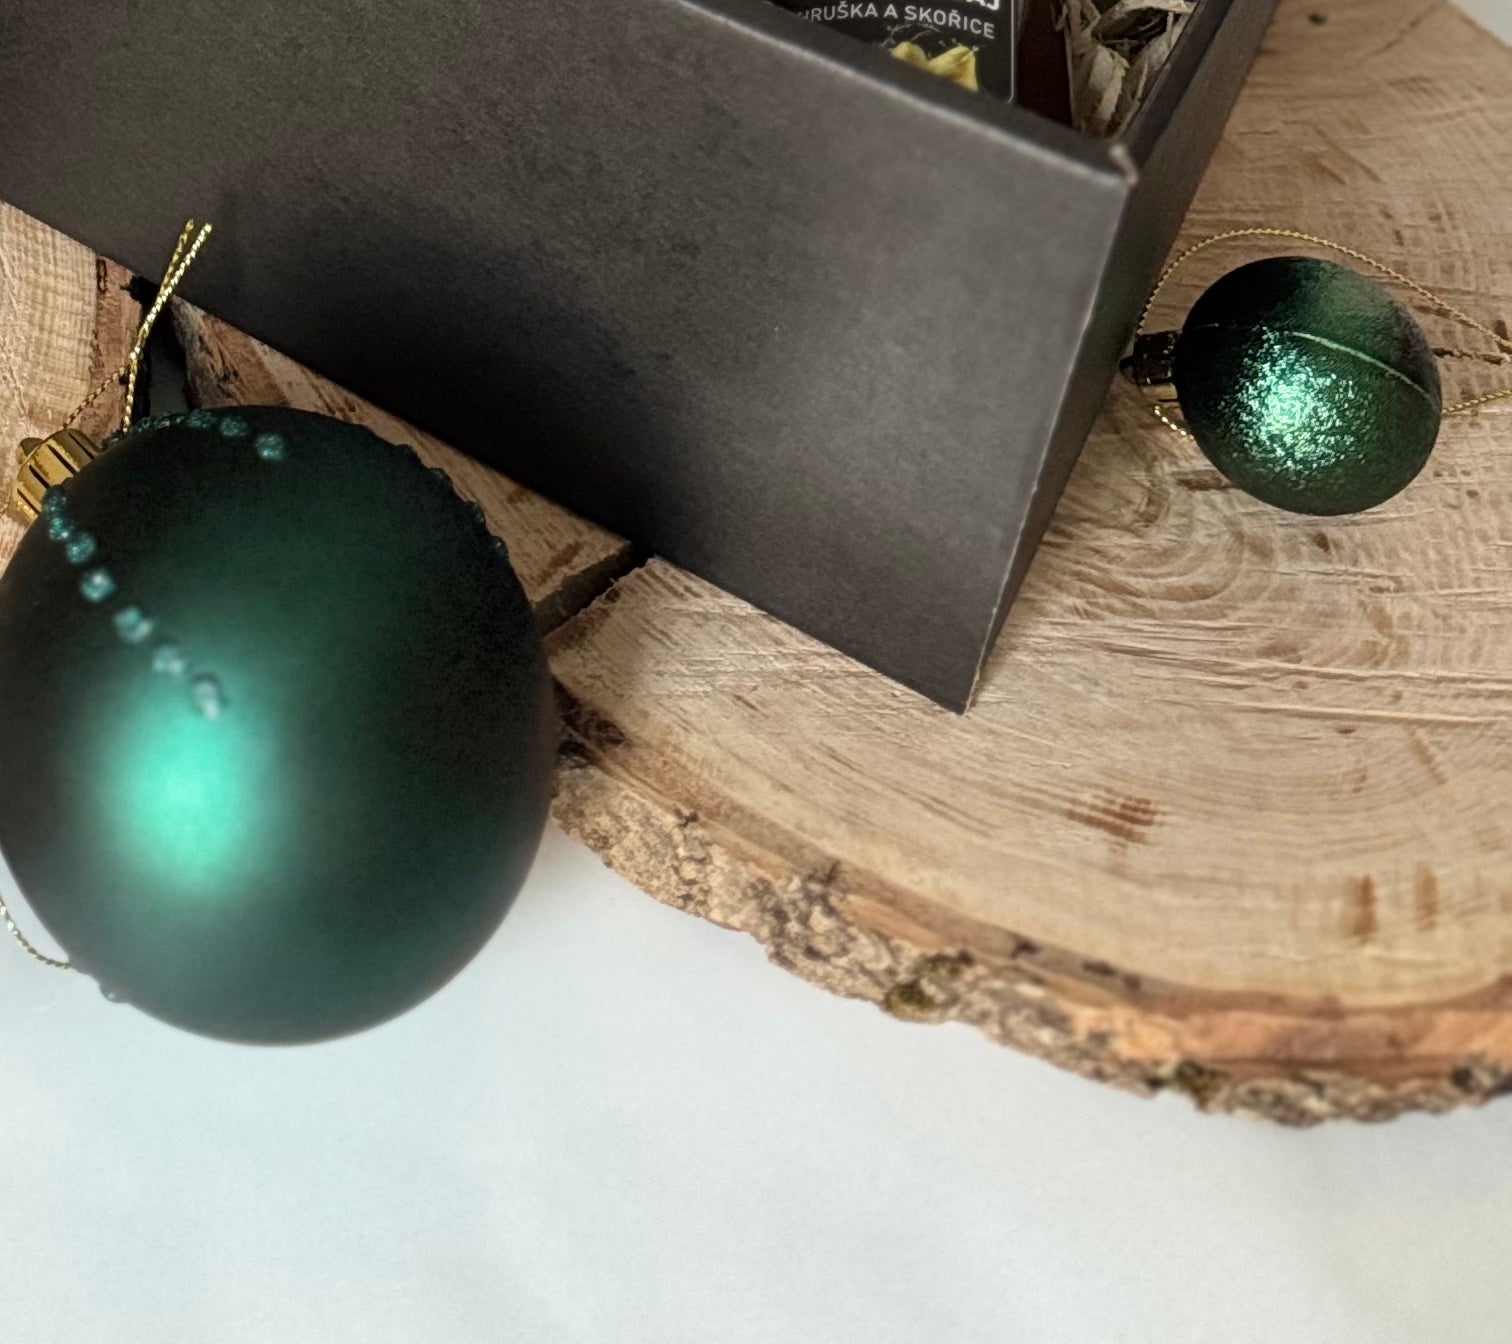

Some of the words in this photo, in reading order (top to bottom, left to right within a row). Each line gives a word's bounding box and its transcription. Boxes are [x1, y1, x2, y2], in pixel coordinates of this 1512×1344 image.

[801, 0, 879, 23] RUŠKA
[883, 3, 899, 19] A
[904, 4, 996, 40] SKOŘICE
